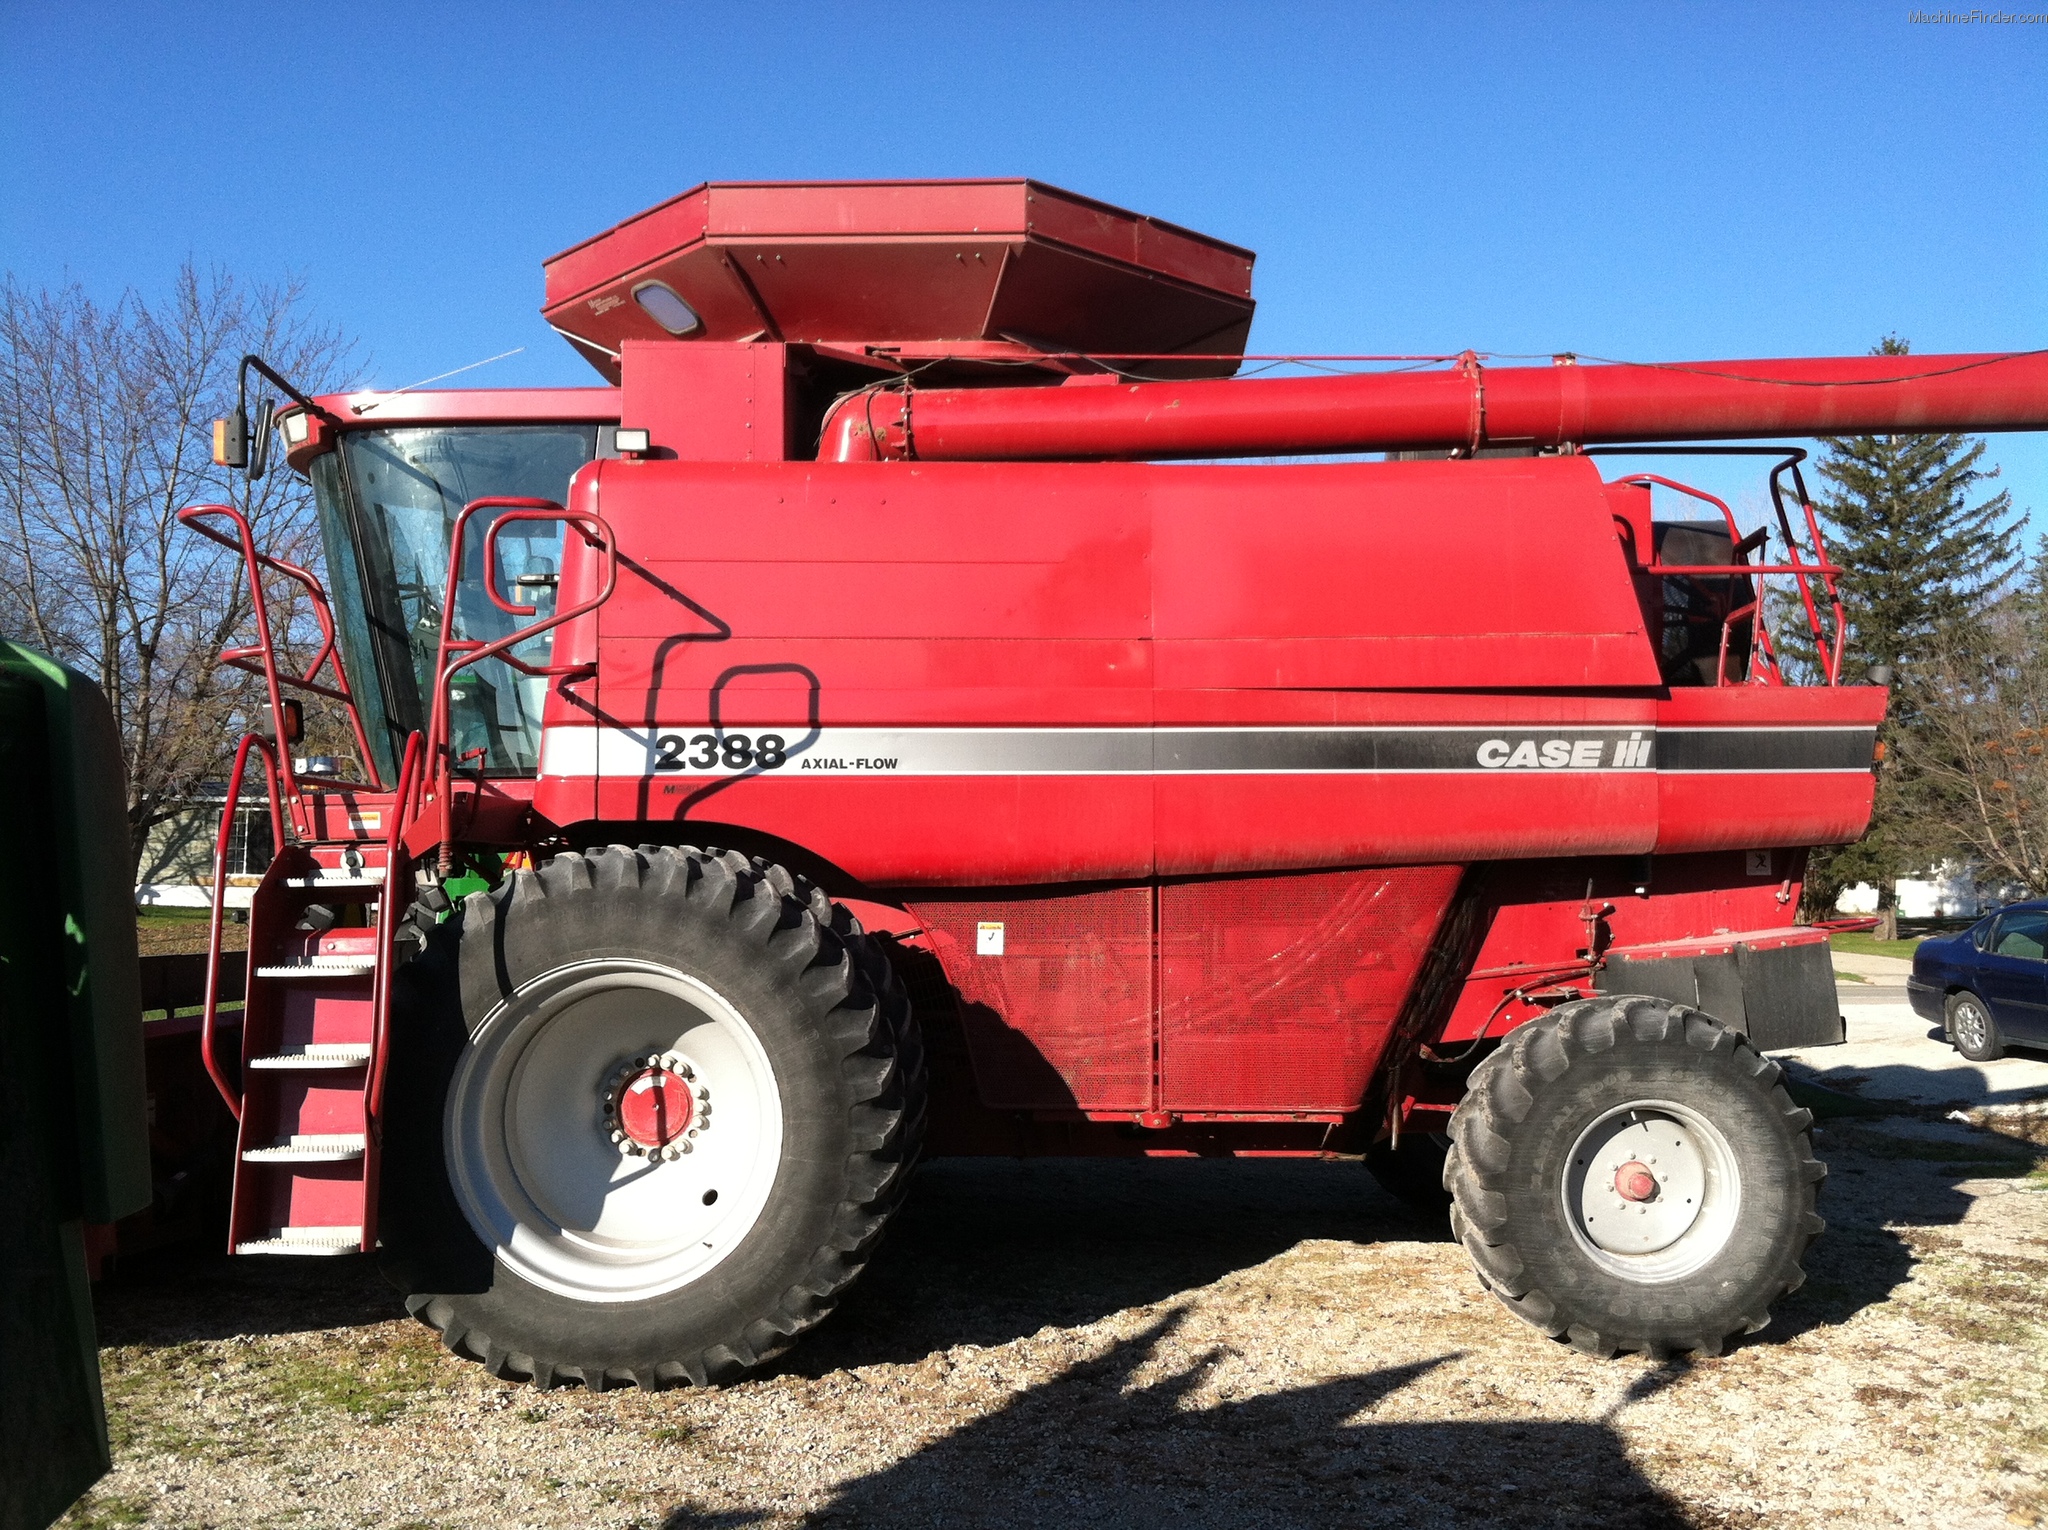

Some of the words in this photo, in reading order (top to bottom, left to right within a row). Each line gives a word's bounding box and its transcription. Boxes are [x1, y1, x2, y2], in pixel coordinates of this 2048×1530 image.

[655, 733, 787, 770] 2388
[801, 757, 899, 770] AXIAL-FLOW
[1476, 739, 1604, 768] CASE
